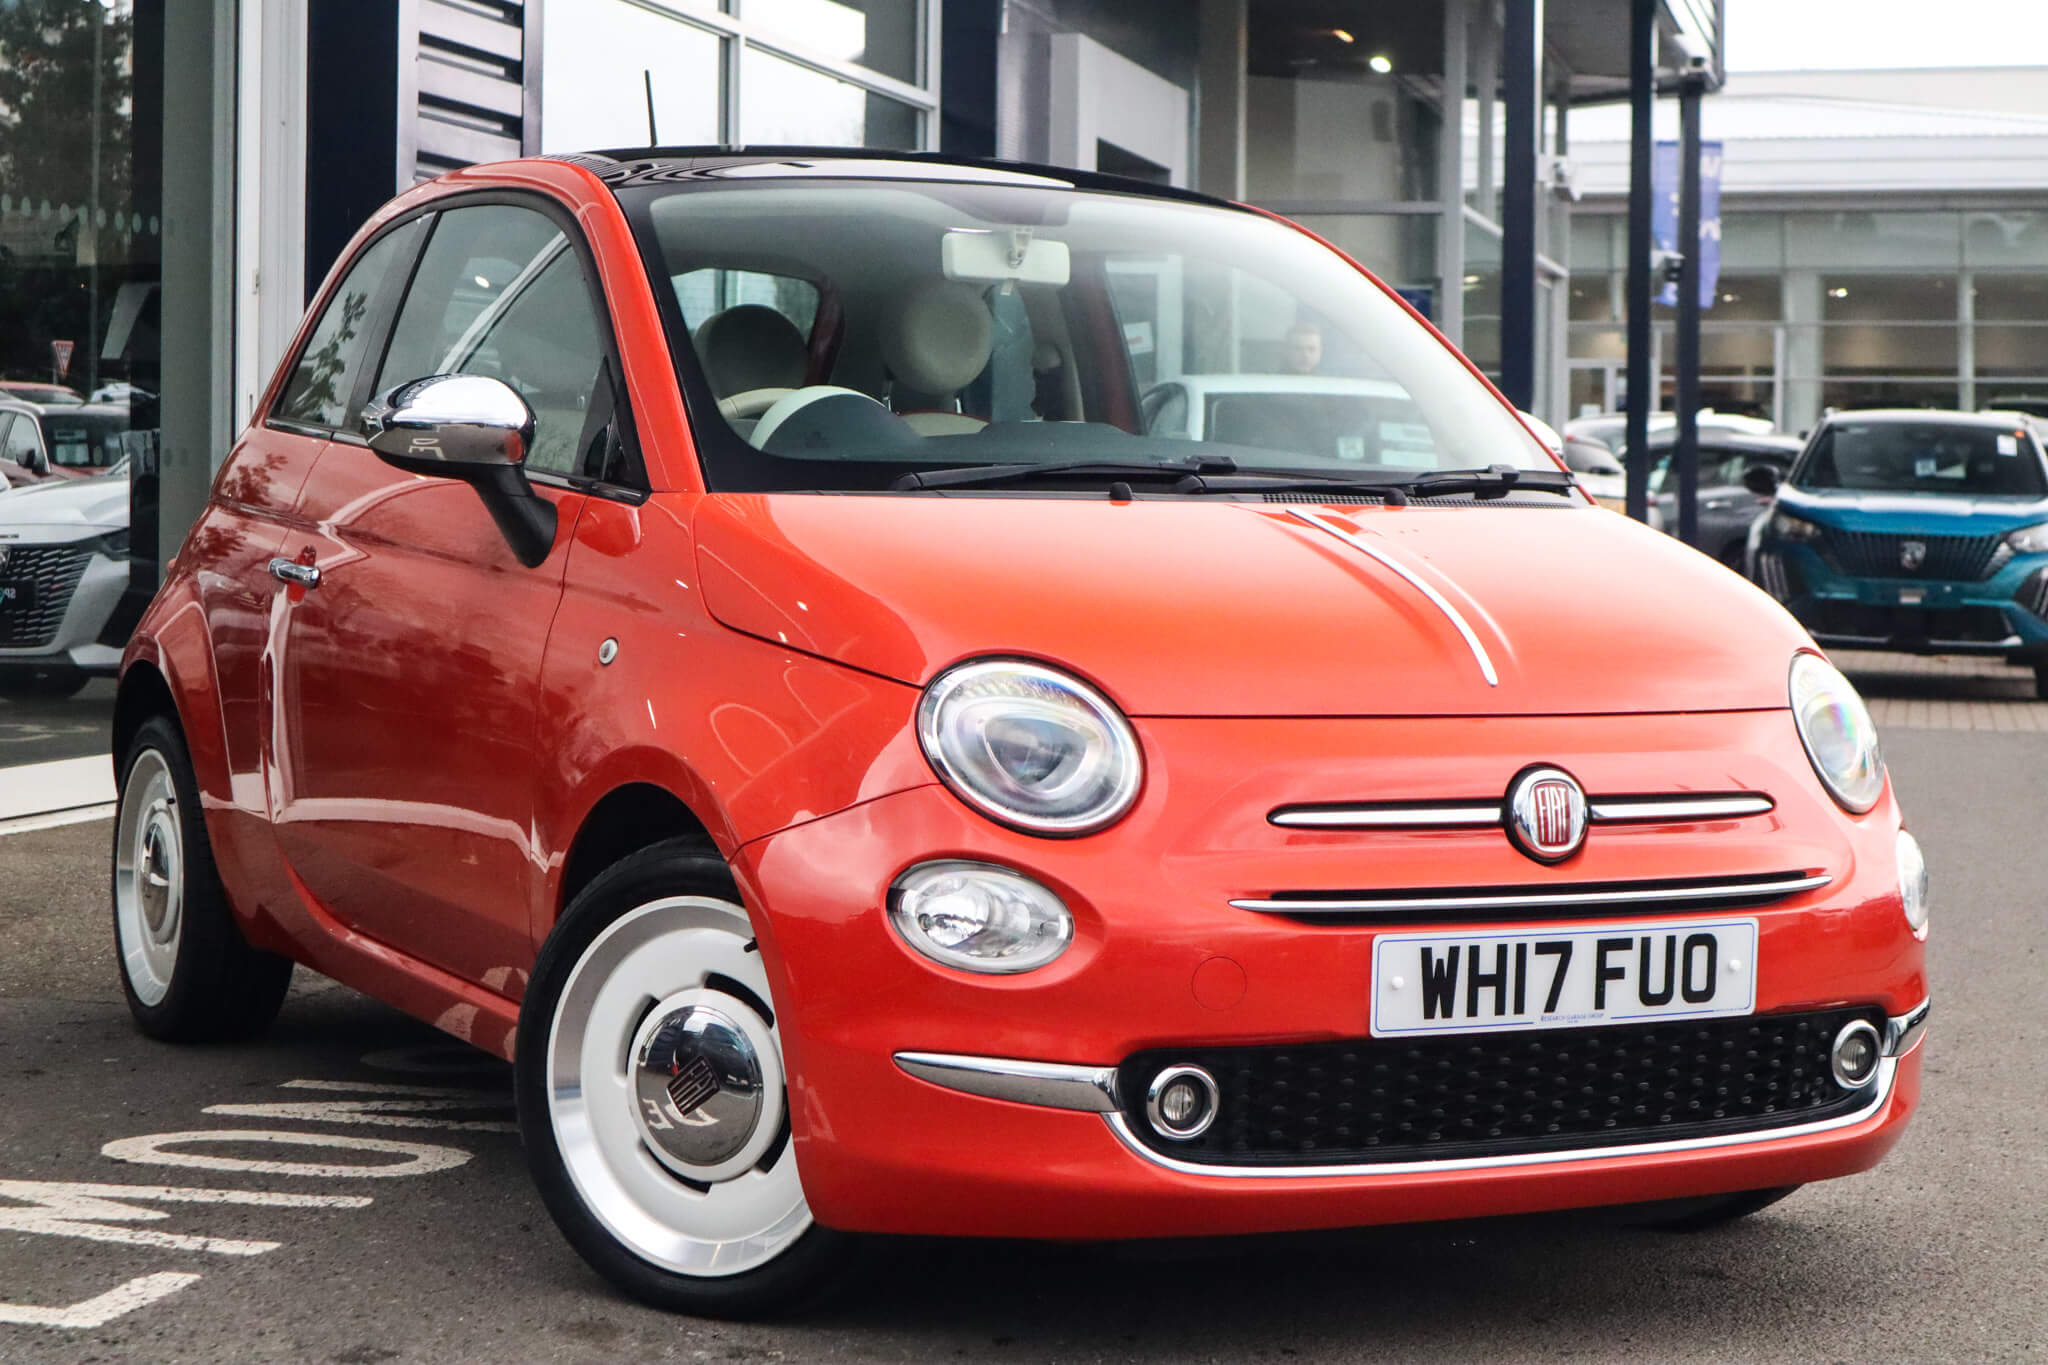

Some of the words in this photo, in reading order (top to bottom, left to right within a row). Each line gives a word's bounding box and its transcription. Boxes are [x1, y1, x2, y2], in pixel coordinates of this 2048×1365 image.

[1536, 786, 1568, 843] FIAT
[1420, 940, 1573, 1020] WH17
[1594, 933, 1718, 1010] FUO
[670, 1058, 720, 1116] FIAT
